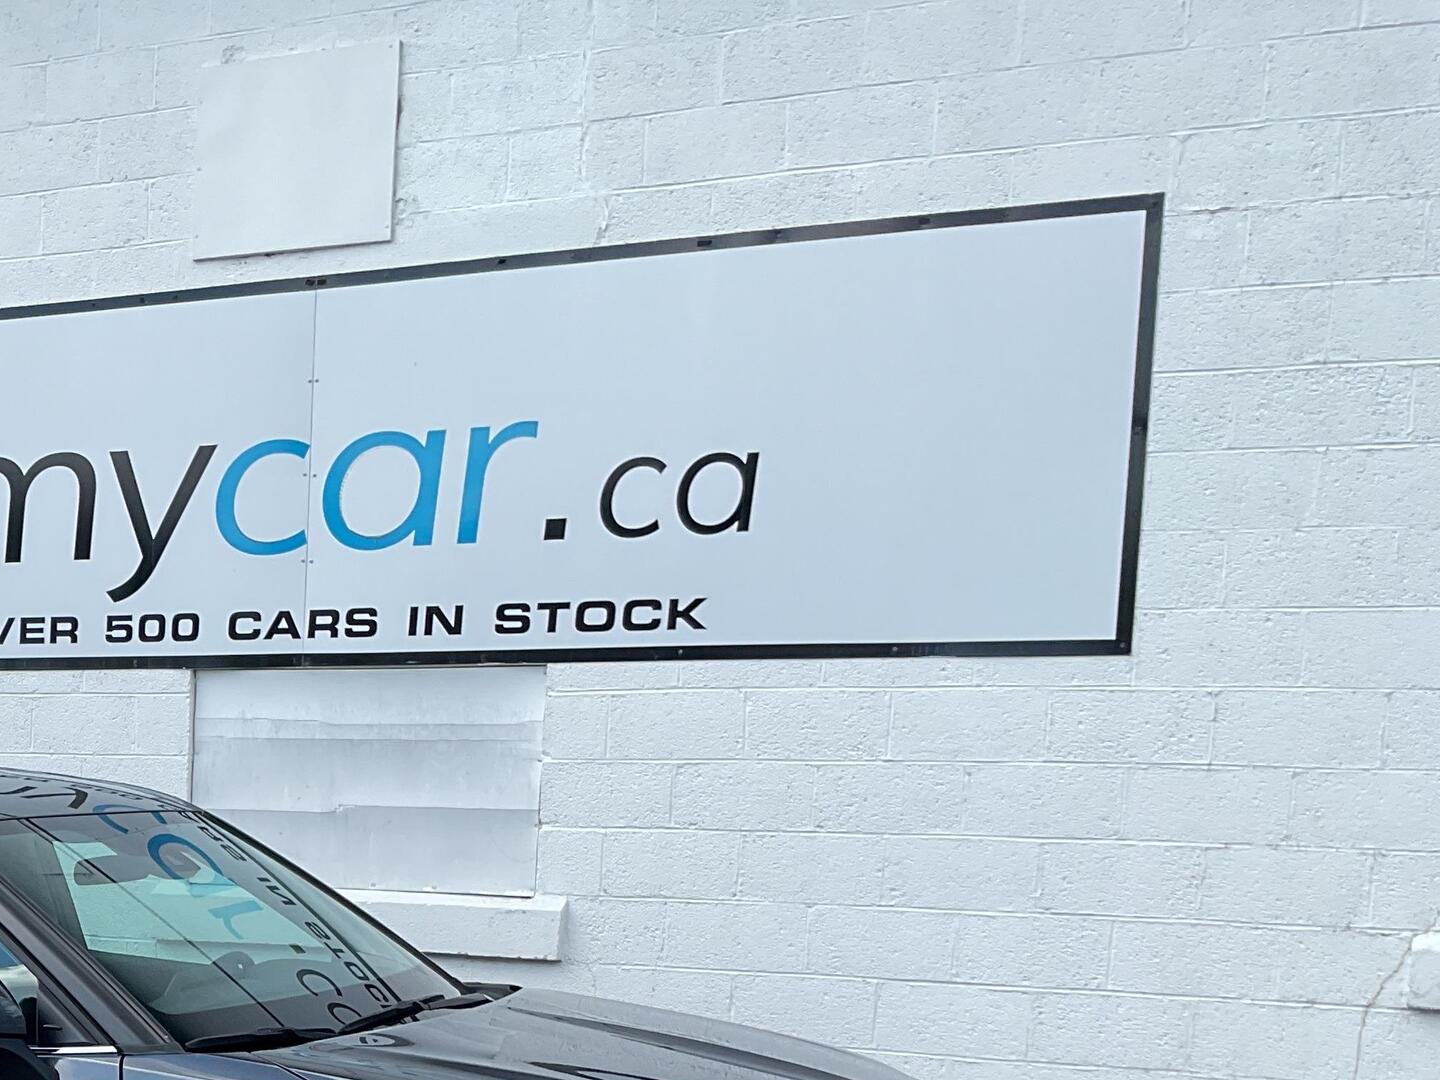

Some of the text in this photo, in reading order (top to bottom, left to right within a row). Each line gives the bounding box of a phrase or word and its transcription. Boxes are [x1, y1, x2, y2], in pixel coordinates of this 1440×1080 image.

[104, 612, 200, 643] 500
[227, 606, 379, 641] CARS
[407, 604, 465, 637] IN
[494, 597, 709, 635] STOCK
